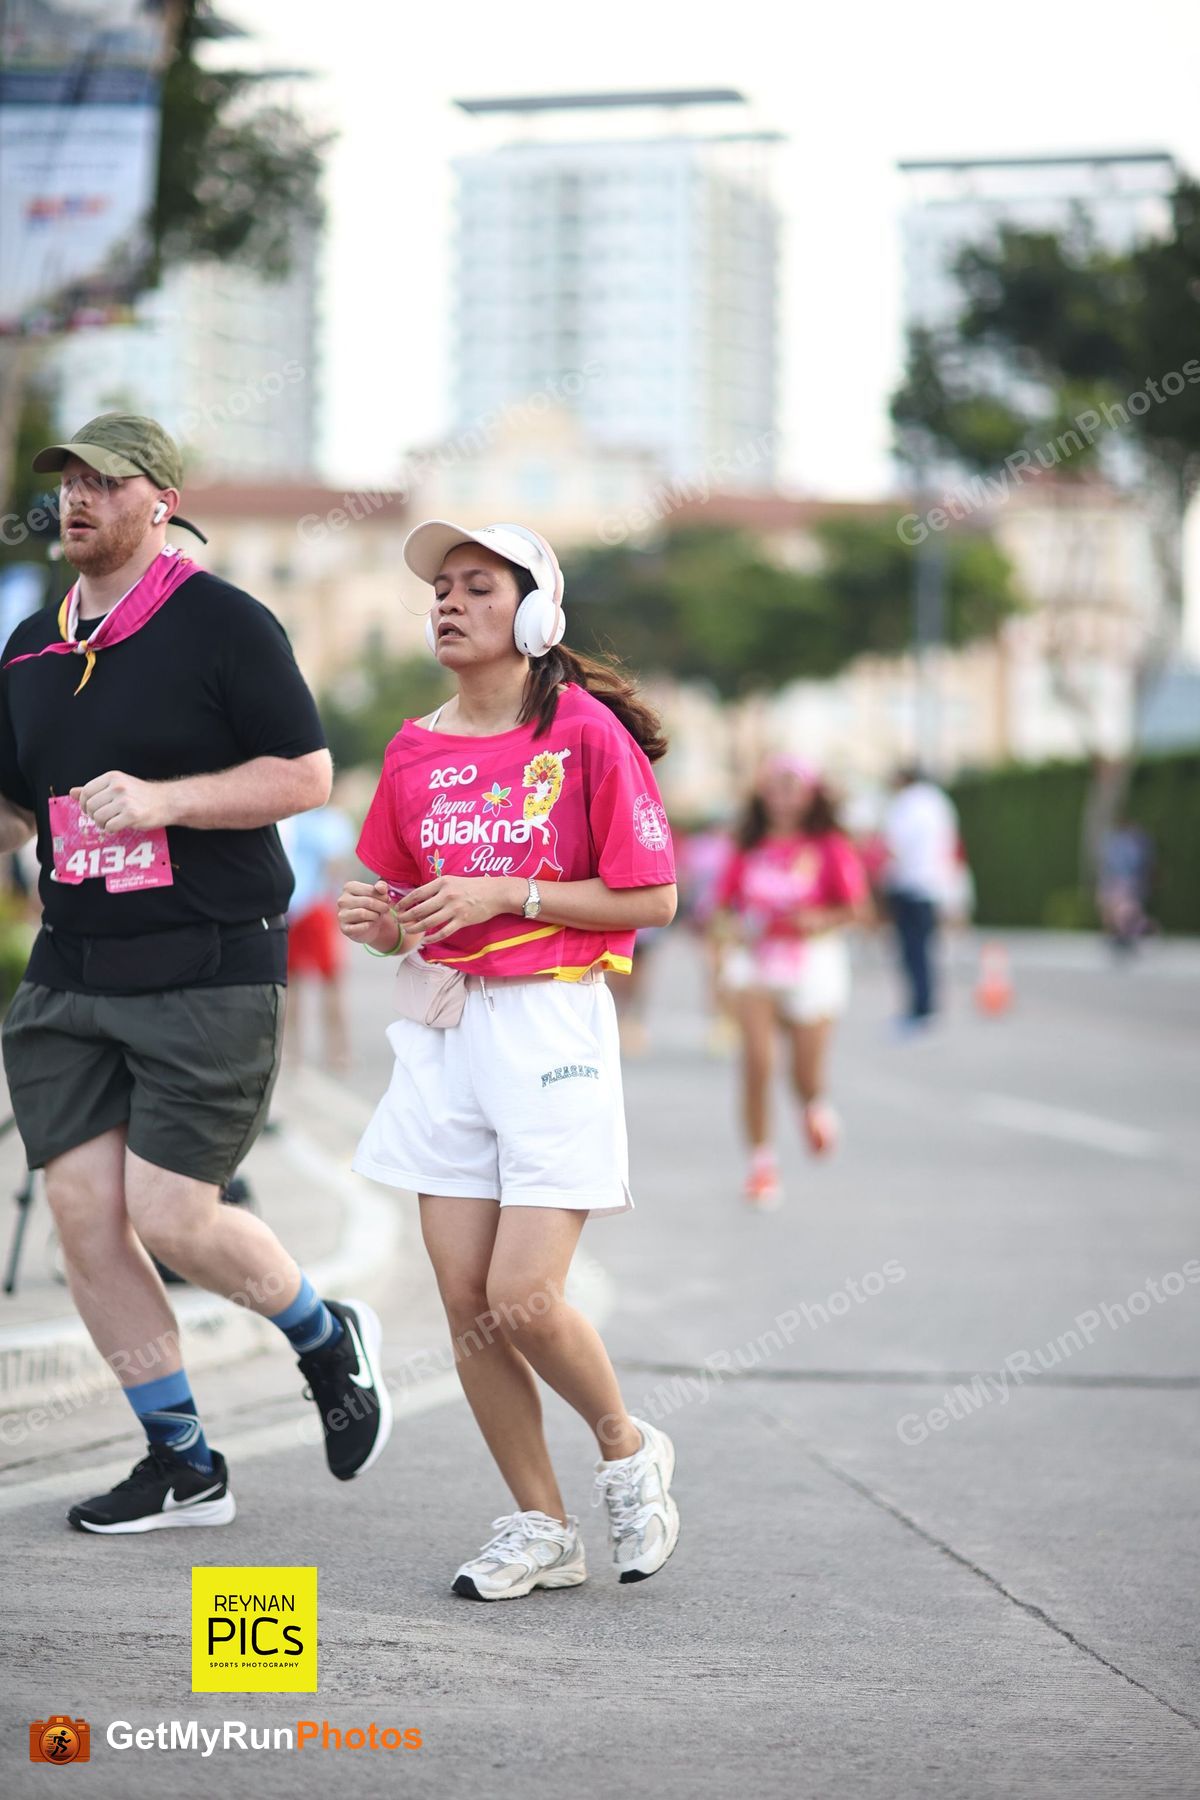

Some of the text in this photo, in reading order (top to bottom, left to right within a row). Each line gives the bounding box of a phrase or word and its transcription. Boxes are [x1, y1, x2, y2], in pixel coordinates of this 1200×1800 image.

[428, 764, 478, 789] 2GO
[425, 793, 476, 821] Reyna
[66, 841, 155, 877] 4134
[463, 844, 514, 874] Run
